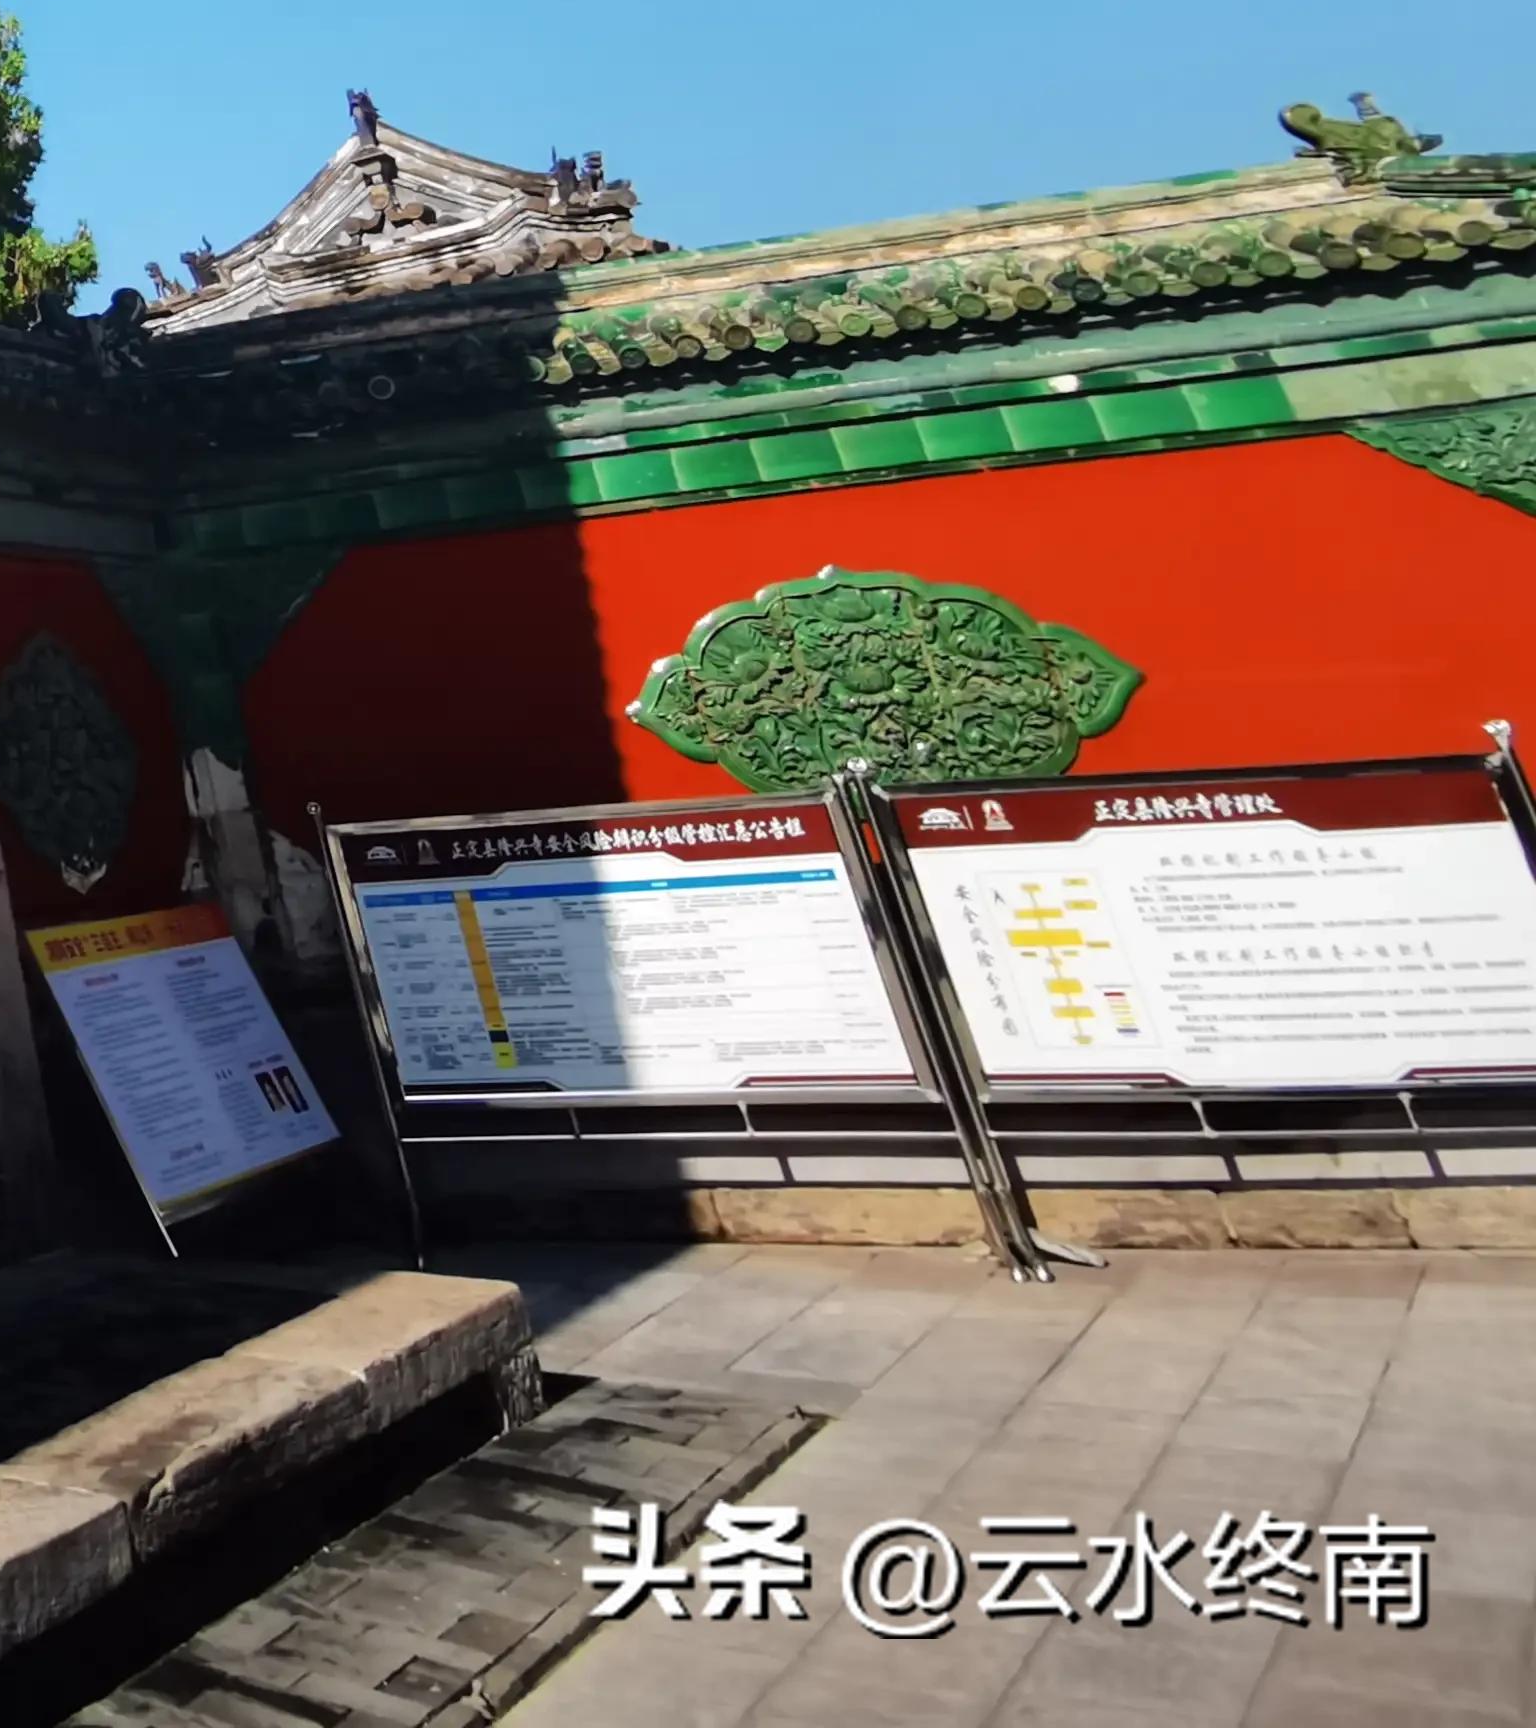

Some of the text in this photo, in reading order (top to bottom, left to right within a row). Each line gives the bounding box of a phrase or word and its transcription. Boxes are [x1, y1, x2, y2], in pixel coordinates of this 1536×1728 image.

[1094, 792, 1283, 821] 正定县隆兴寺管理处
